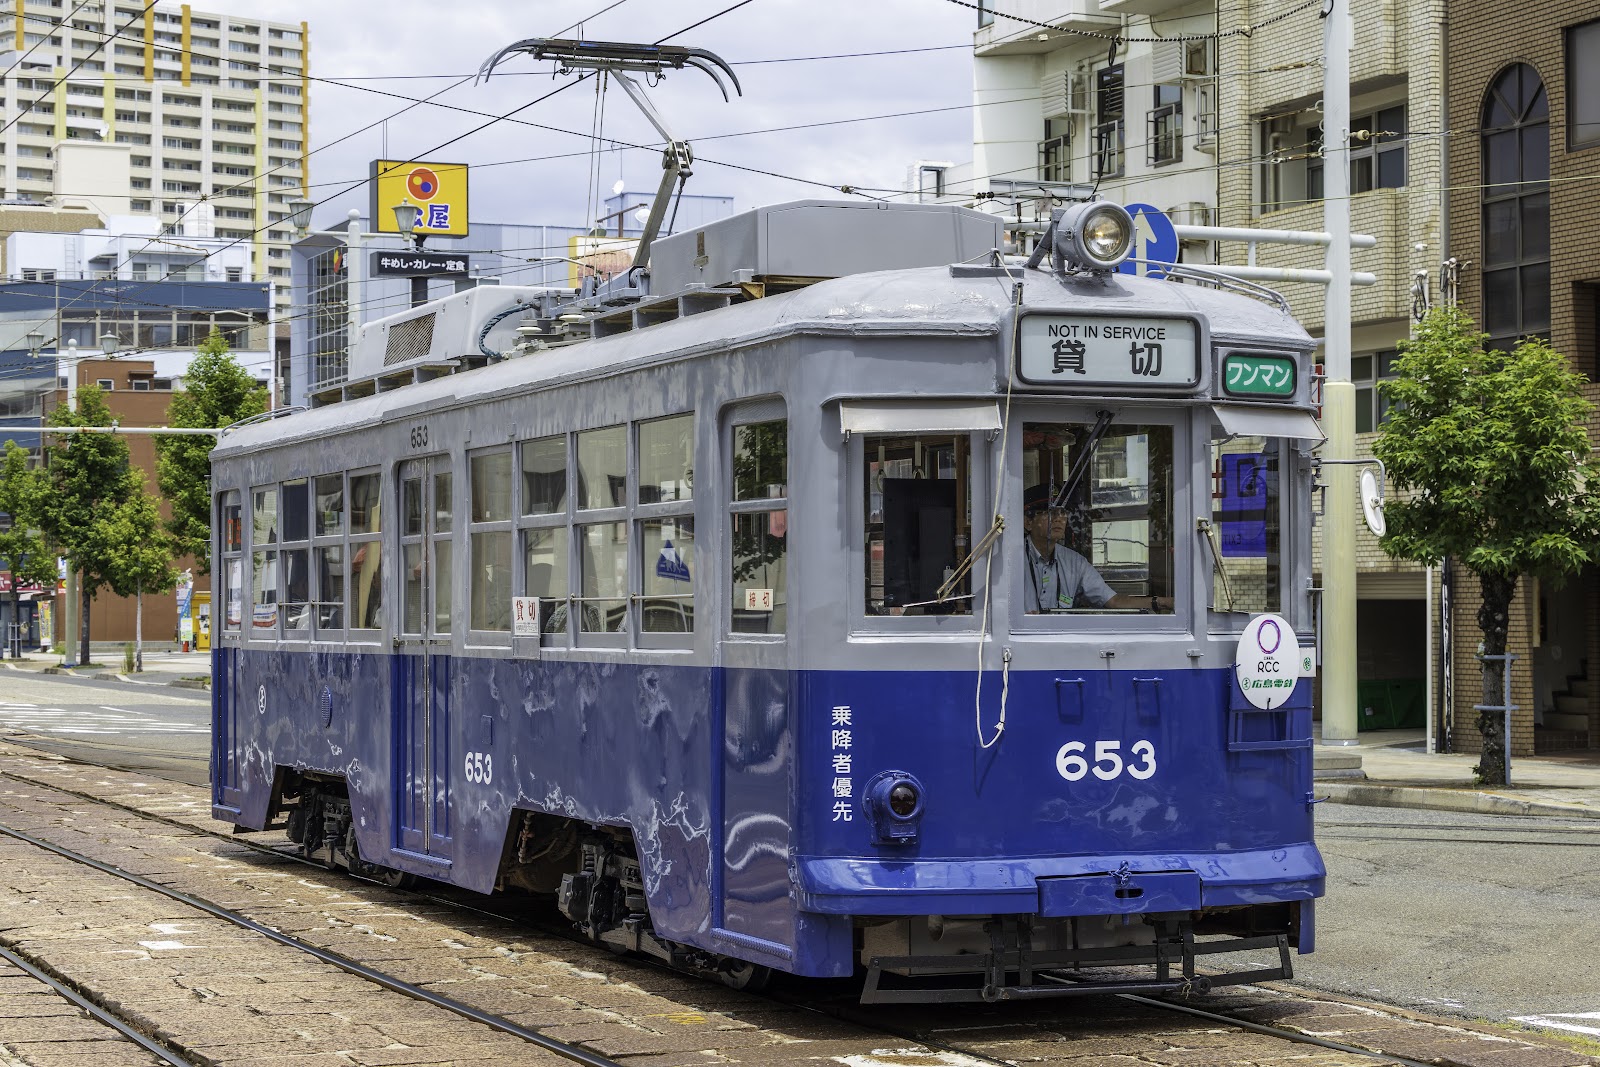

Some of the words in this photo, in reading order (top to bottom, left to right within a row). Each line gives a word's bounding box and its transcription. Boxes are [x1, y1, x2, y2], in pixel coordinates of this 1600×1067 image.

[380, 257, 466, 272] 牛めし・カレー・定食
[1048, 324, 1080, 338] NOT
[1084, 326, 1098, 339] IN
[1103, 326, 1166, 340] SERVICE
[1051, 339, 1163, 377] 貸切
[1227, 361, 1291, 388] ワンマン
[410, 424, 429, 449] 653
[516, 599, 536, 621] 貸切
[1257, 661, 1280, 673] RCC
[1251, 678, 1293, 689] 広島電鉄
[464, 751, 493, 785] 653
[831, 705, 853, 822] 乗降者優先
[1055, 739, 1157, 782] 653
